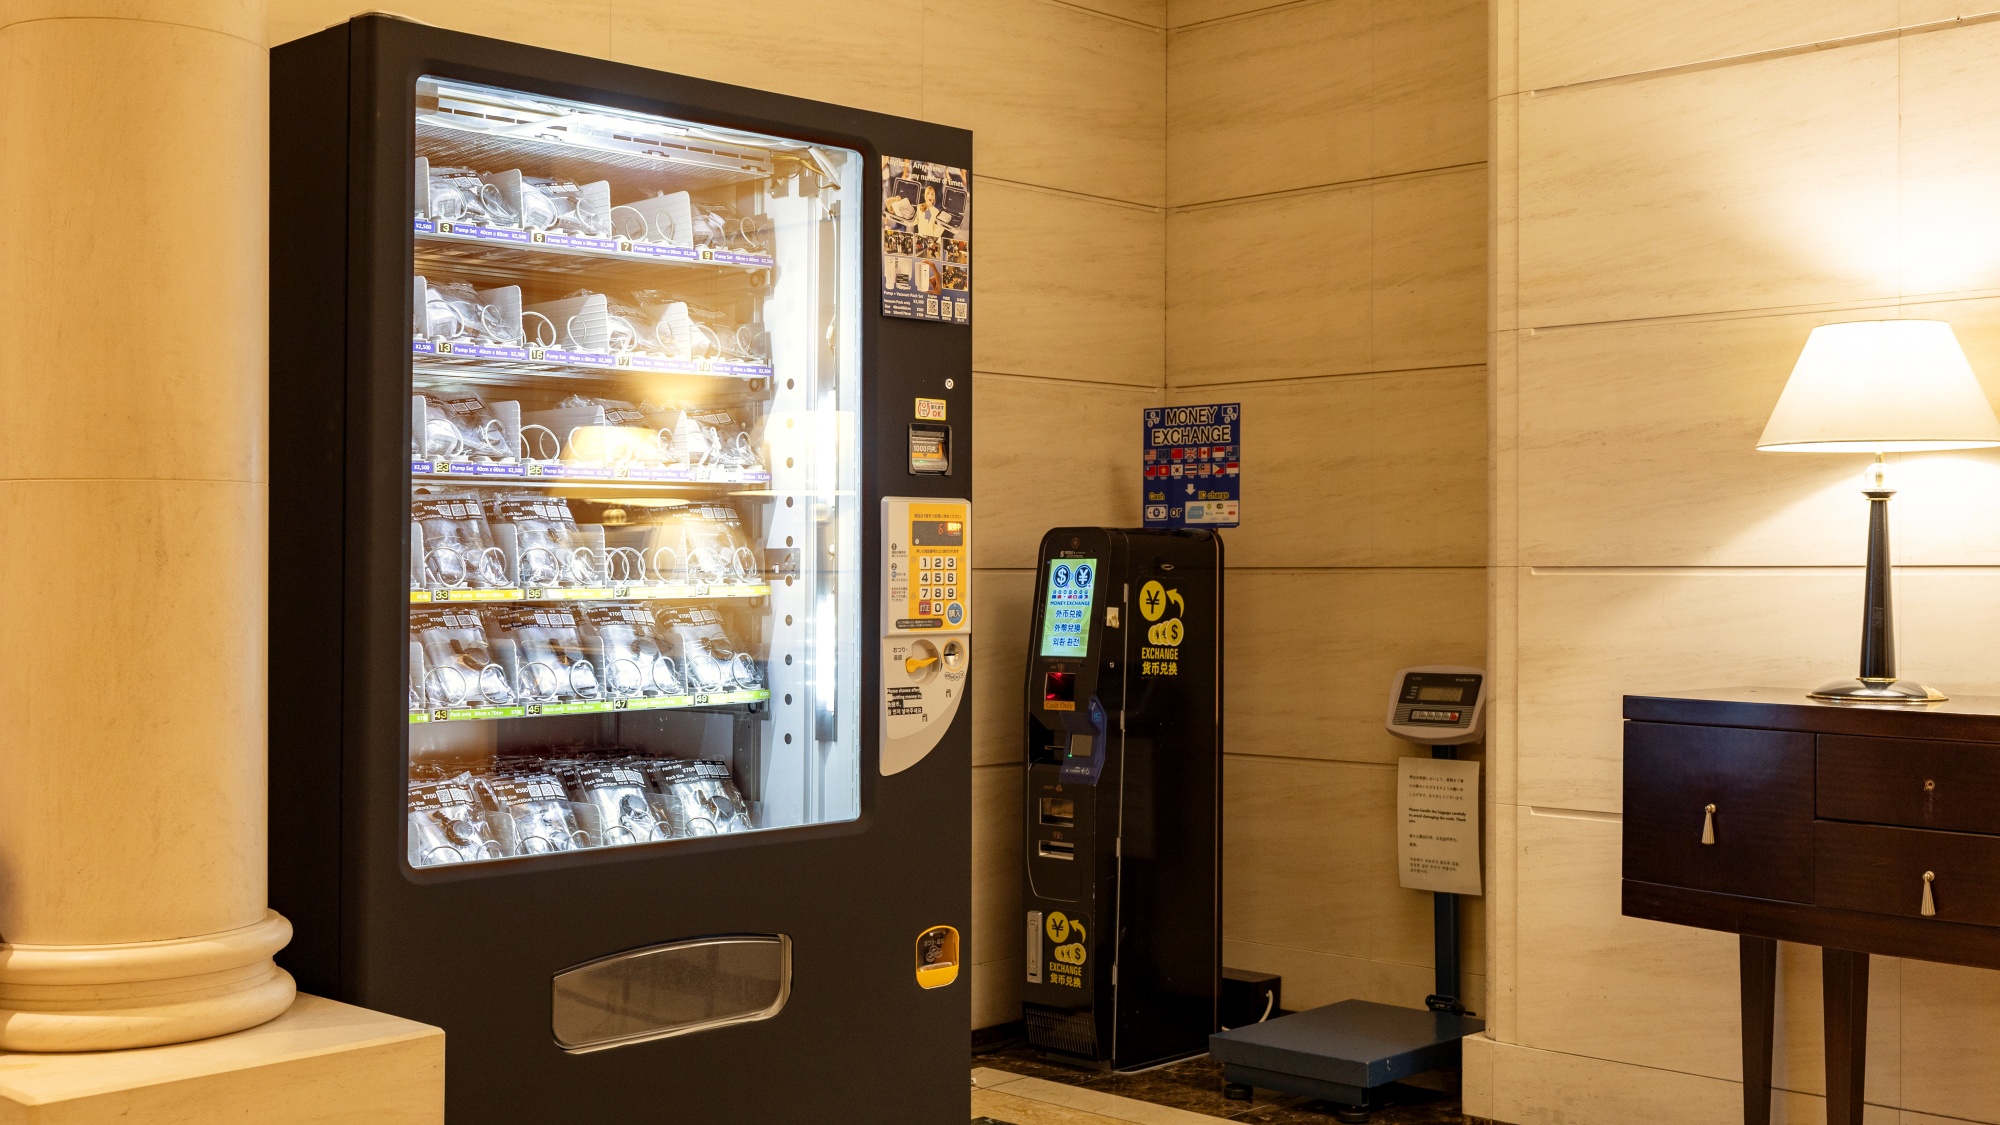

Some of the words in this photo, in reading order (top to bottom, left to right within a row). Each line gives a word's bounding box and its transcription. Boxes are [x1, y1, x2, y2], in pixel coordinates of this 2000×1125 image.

[920, 174, 941, 184] number
[442, 223, 450, 232] 3
[455, 226, 467, 235] Pump
[480, 229, 492, 237] 40cm
[536, 233, 543, 242] 5
[623, 242, 629, 251] 7
[705, 251, 710, 259] 9
[439, 344, 451, 352] 13
[454, 346, 468, 355] Pump
[531, 350, 543, 360] 15
[1165, 405, 1218, 426] MONEY
[1152, 425, 1231, 446] EXCHANGE
[436, 462, 449, 472] 23
[452, 465, 465, 473] Pump
[465, 465, 474, 473] Set
[529, 465, 541, 475] 25
[544, 468, 556, 476] Pump
[1149, 491, 1165, 501] Cash
[1207, 491, 1229, 500] charge
[1170, 507, 1182, 518] or
[923, 558, 927, 567] 1
[935, 558, 941, 567] 2
[947, 558, 954, 567] 3
[922, 573, 928, 582] 4
[935, 573, 941, 582] 5
[947, 573, 954, 582] 6
[435, 590, 449, 600] 33
[528, 589, 541, 598] 35
[615, 587, 627, 597] 37
[922, 589, 928, 598] 7
[935, 589, 941, 598] 8
[947, 589, 954, 598] 9
[935, 603, 941, 613] 0
[1141, 647, 1179, 660] EXCHANGE
[1142, 661, 1178, 676] 货币兑换
[615, 699, 626, 709] 47
[697, 694, 707, 704] 49
[528, 704, 540, 713] 45
[434, 710, 447, 719] 43
[1049, 961, 1082, 976] EXCHANGE
